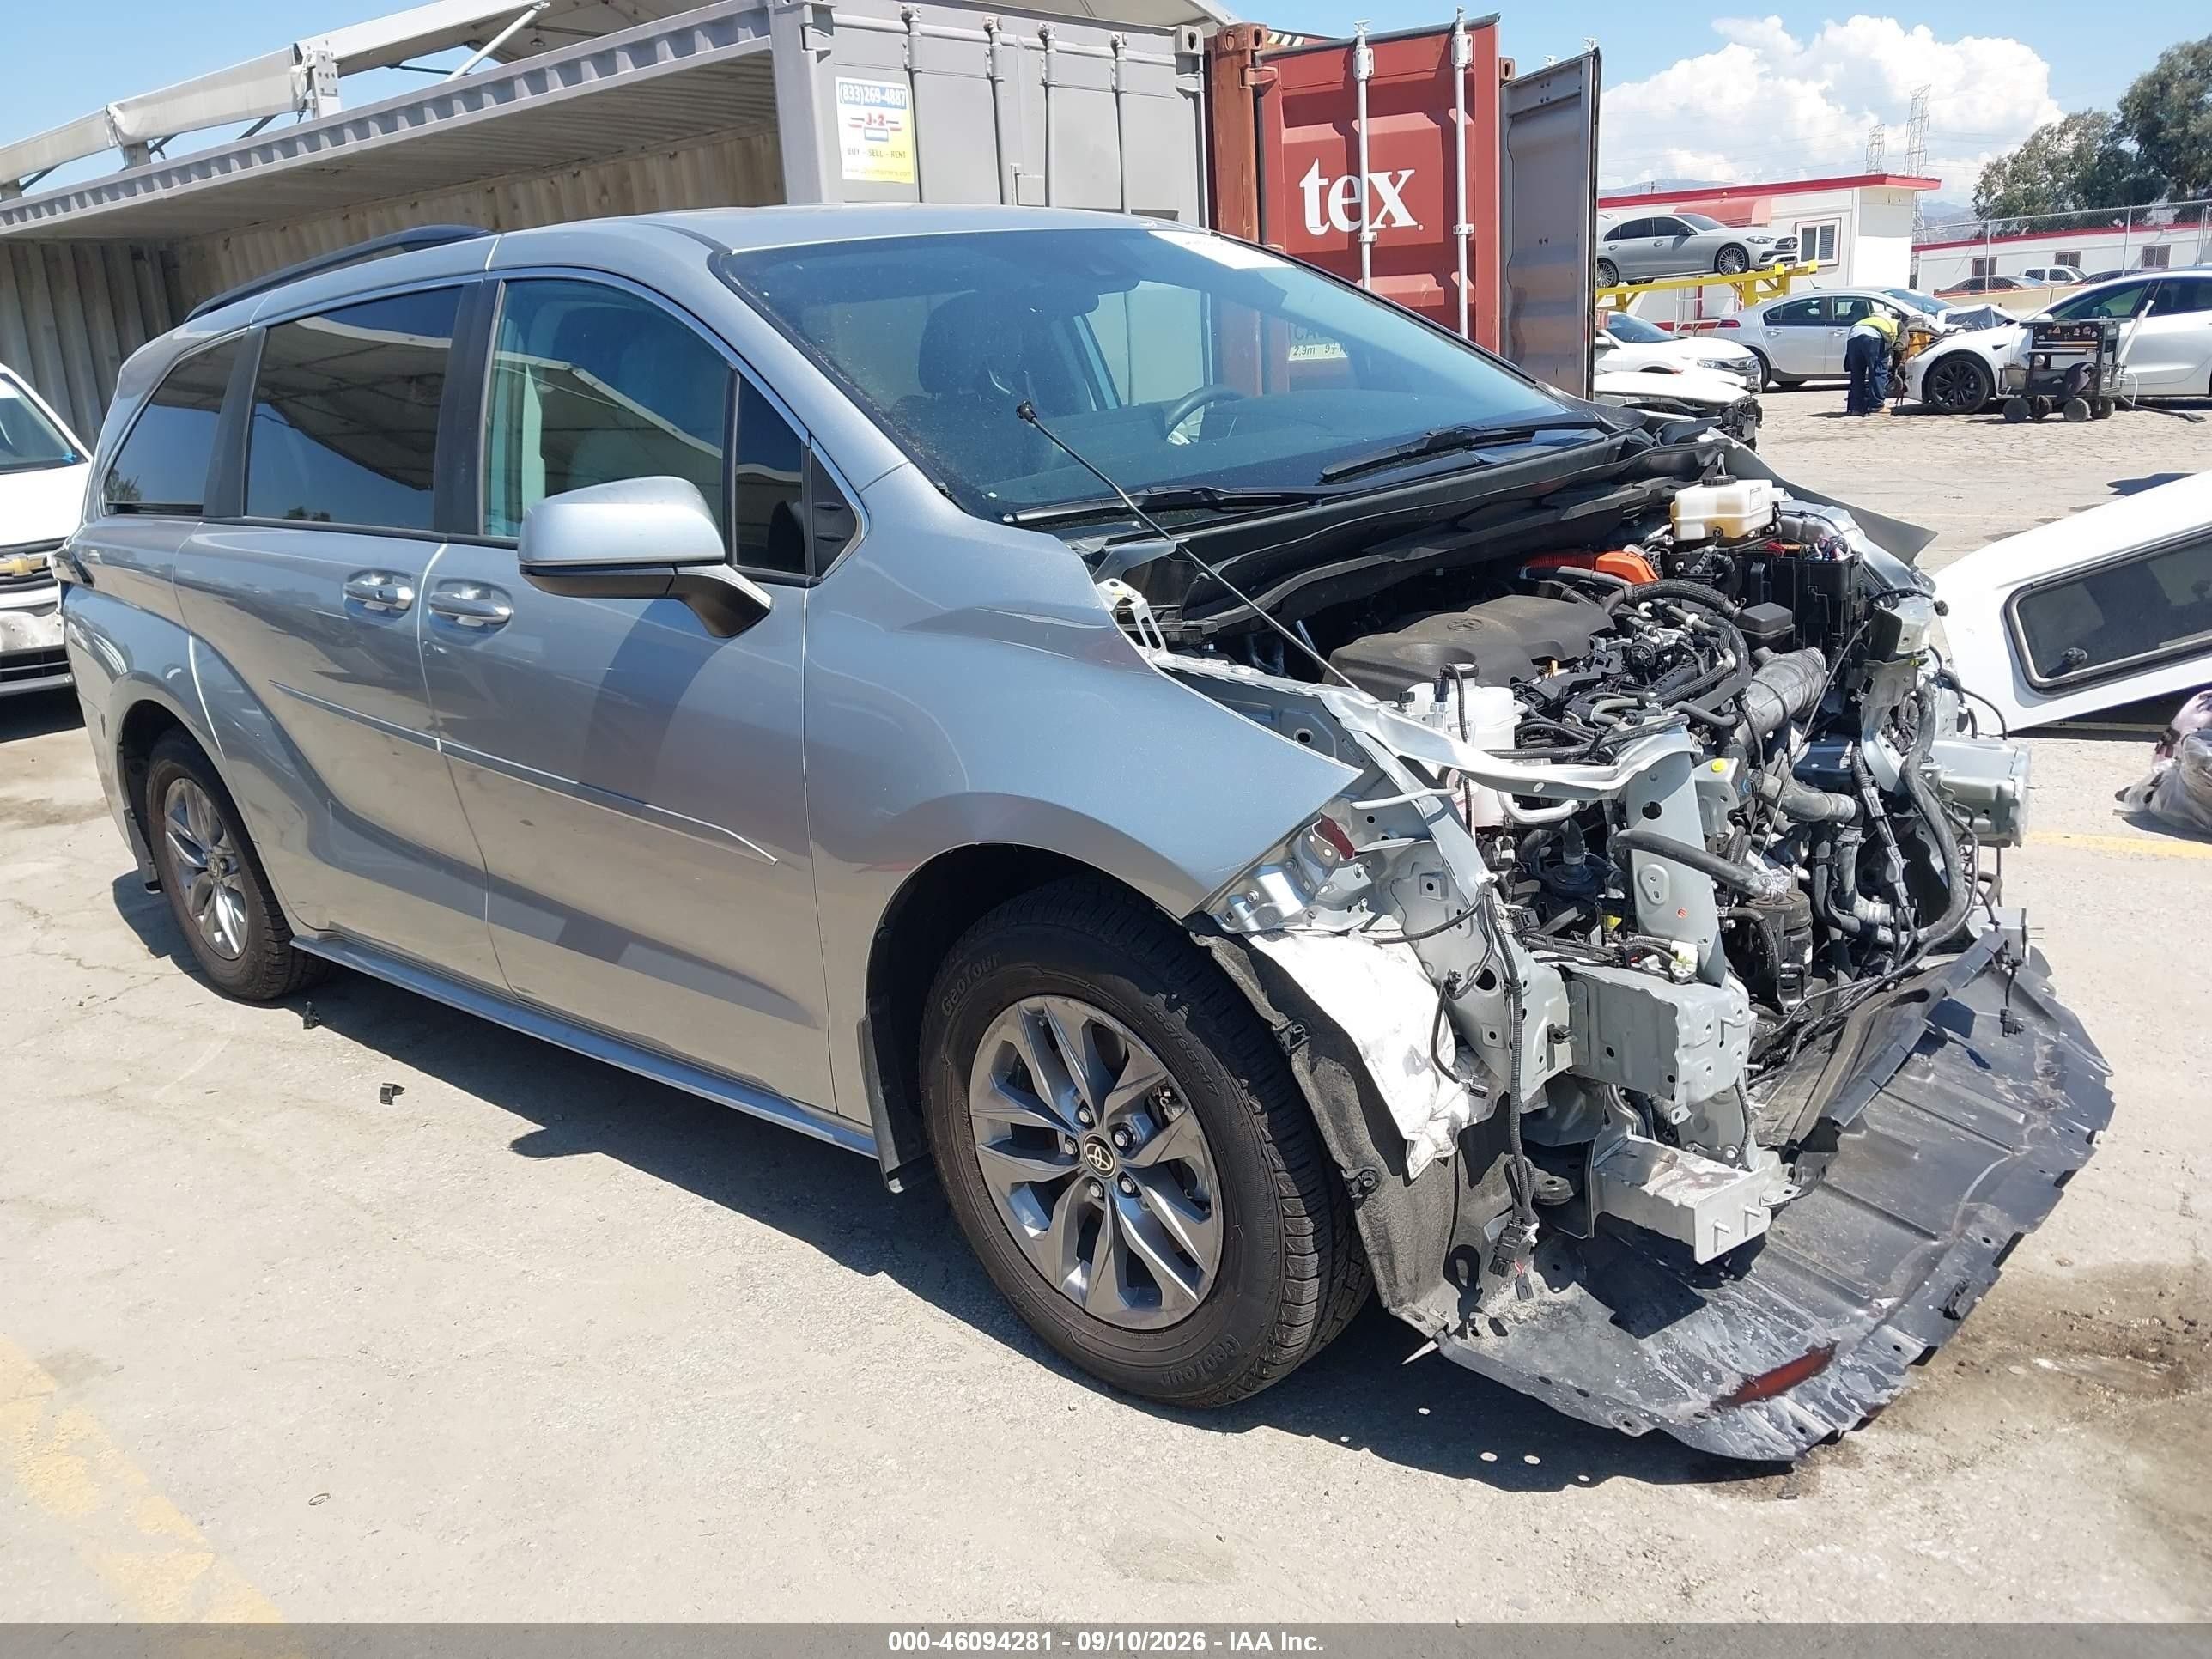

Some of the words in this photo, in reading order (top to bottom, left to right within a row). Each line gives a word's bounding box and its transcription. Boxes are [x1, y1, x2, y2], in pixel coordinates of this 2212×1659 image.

[868, 149, 884, 158] SELL
[890, 150, 906, 159] RENT
[941, 954, 1000, 1018] GeoTour
